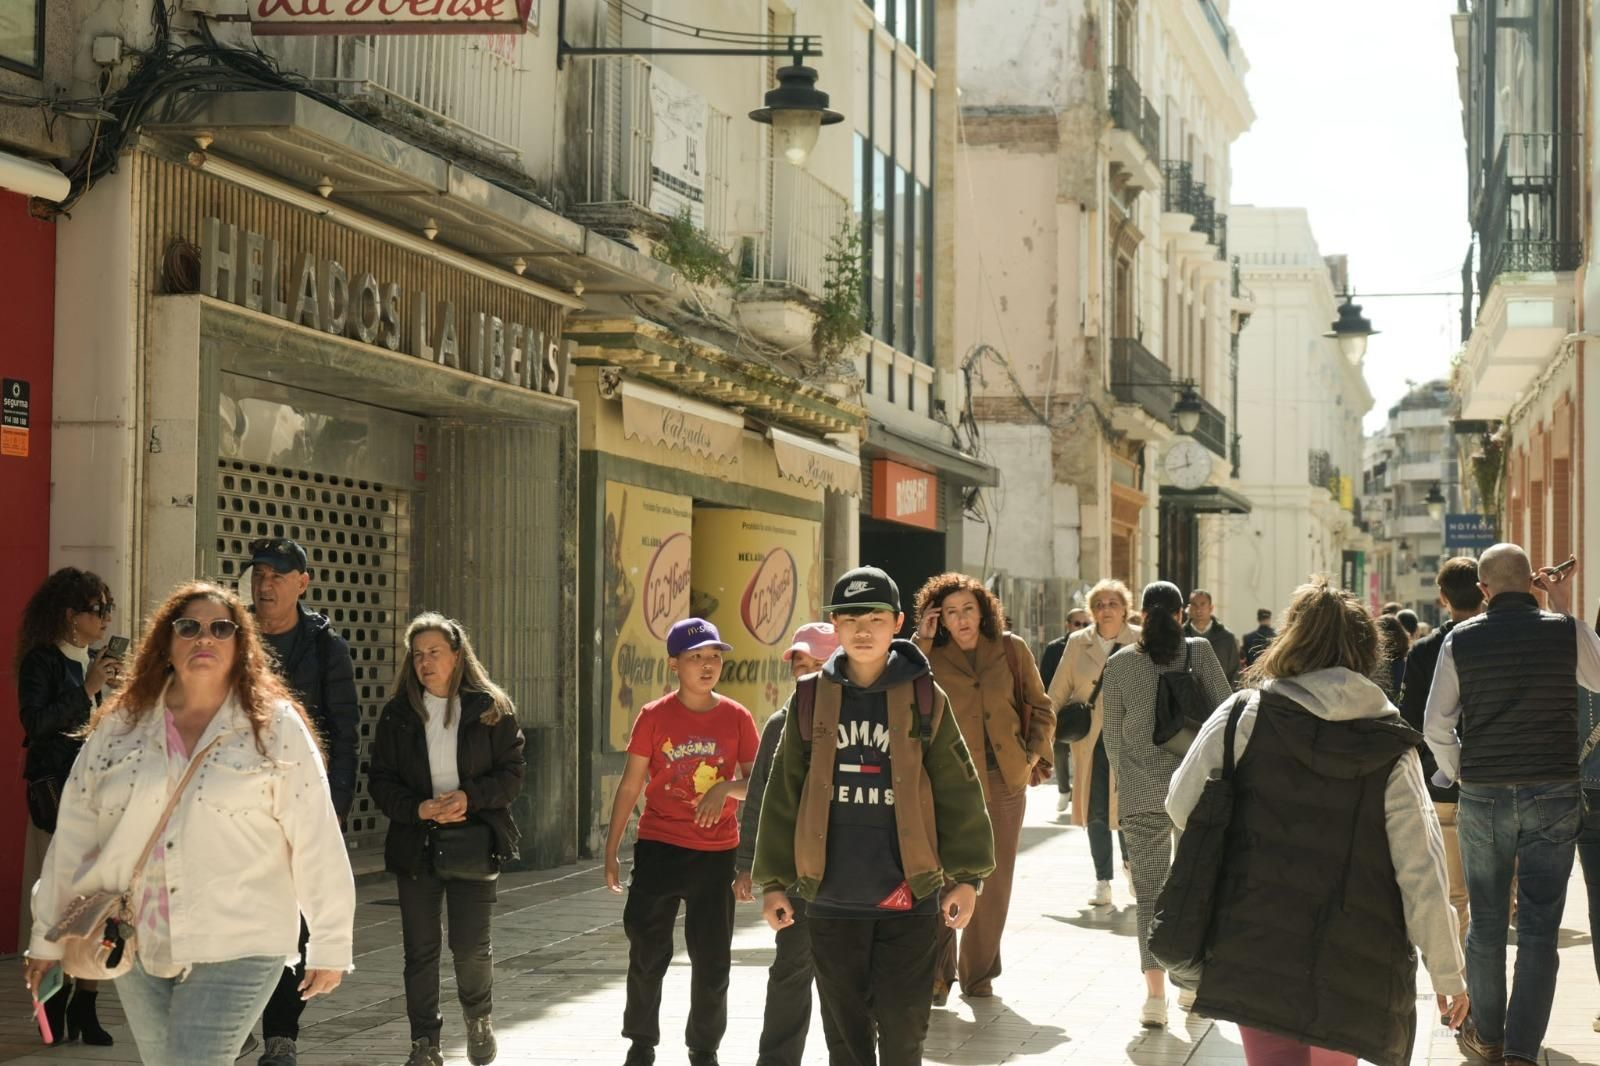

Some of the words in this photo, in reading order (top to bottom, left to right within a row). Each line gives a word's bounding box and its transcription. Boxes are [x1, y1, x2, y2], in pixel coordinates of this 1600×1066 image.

[200, 216, 401, 351] HELADOS
[412, 290, 460, 371] LA
[470, 311, 579, 399] IBENSE
[660, 408, 711, 450] Calzados
[848, 580, 869, 591] NIKE
[836, 720, 892, 759] OMM
[831, 785, 895, 806] EANS
